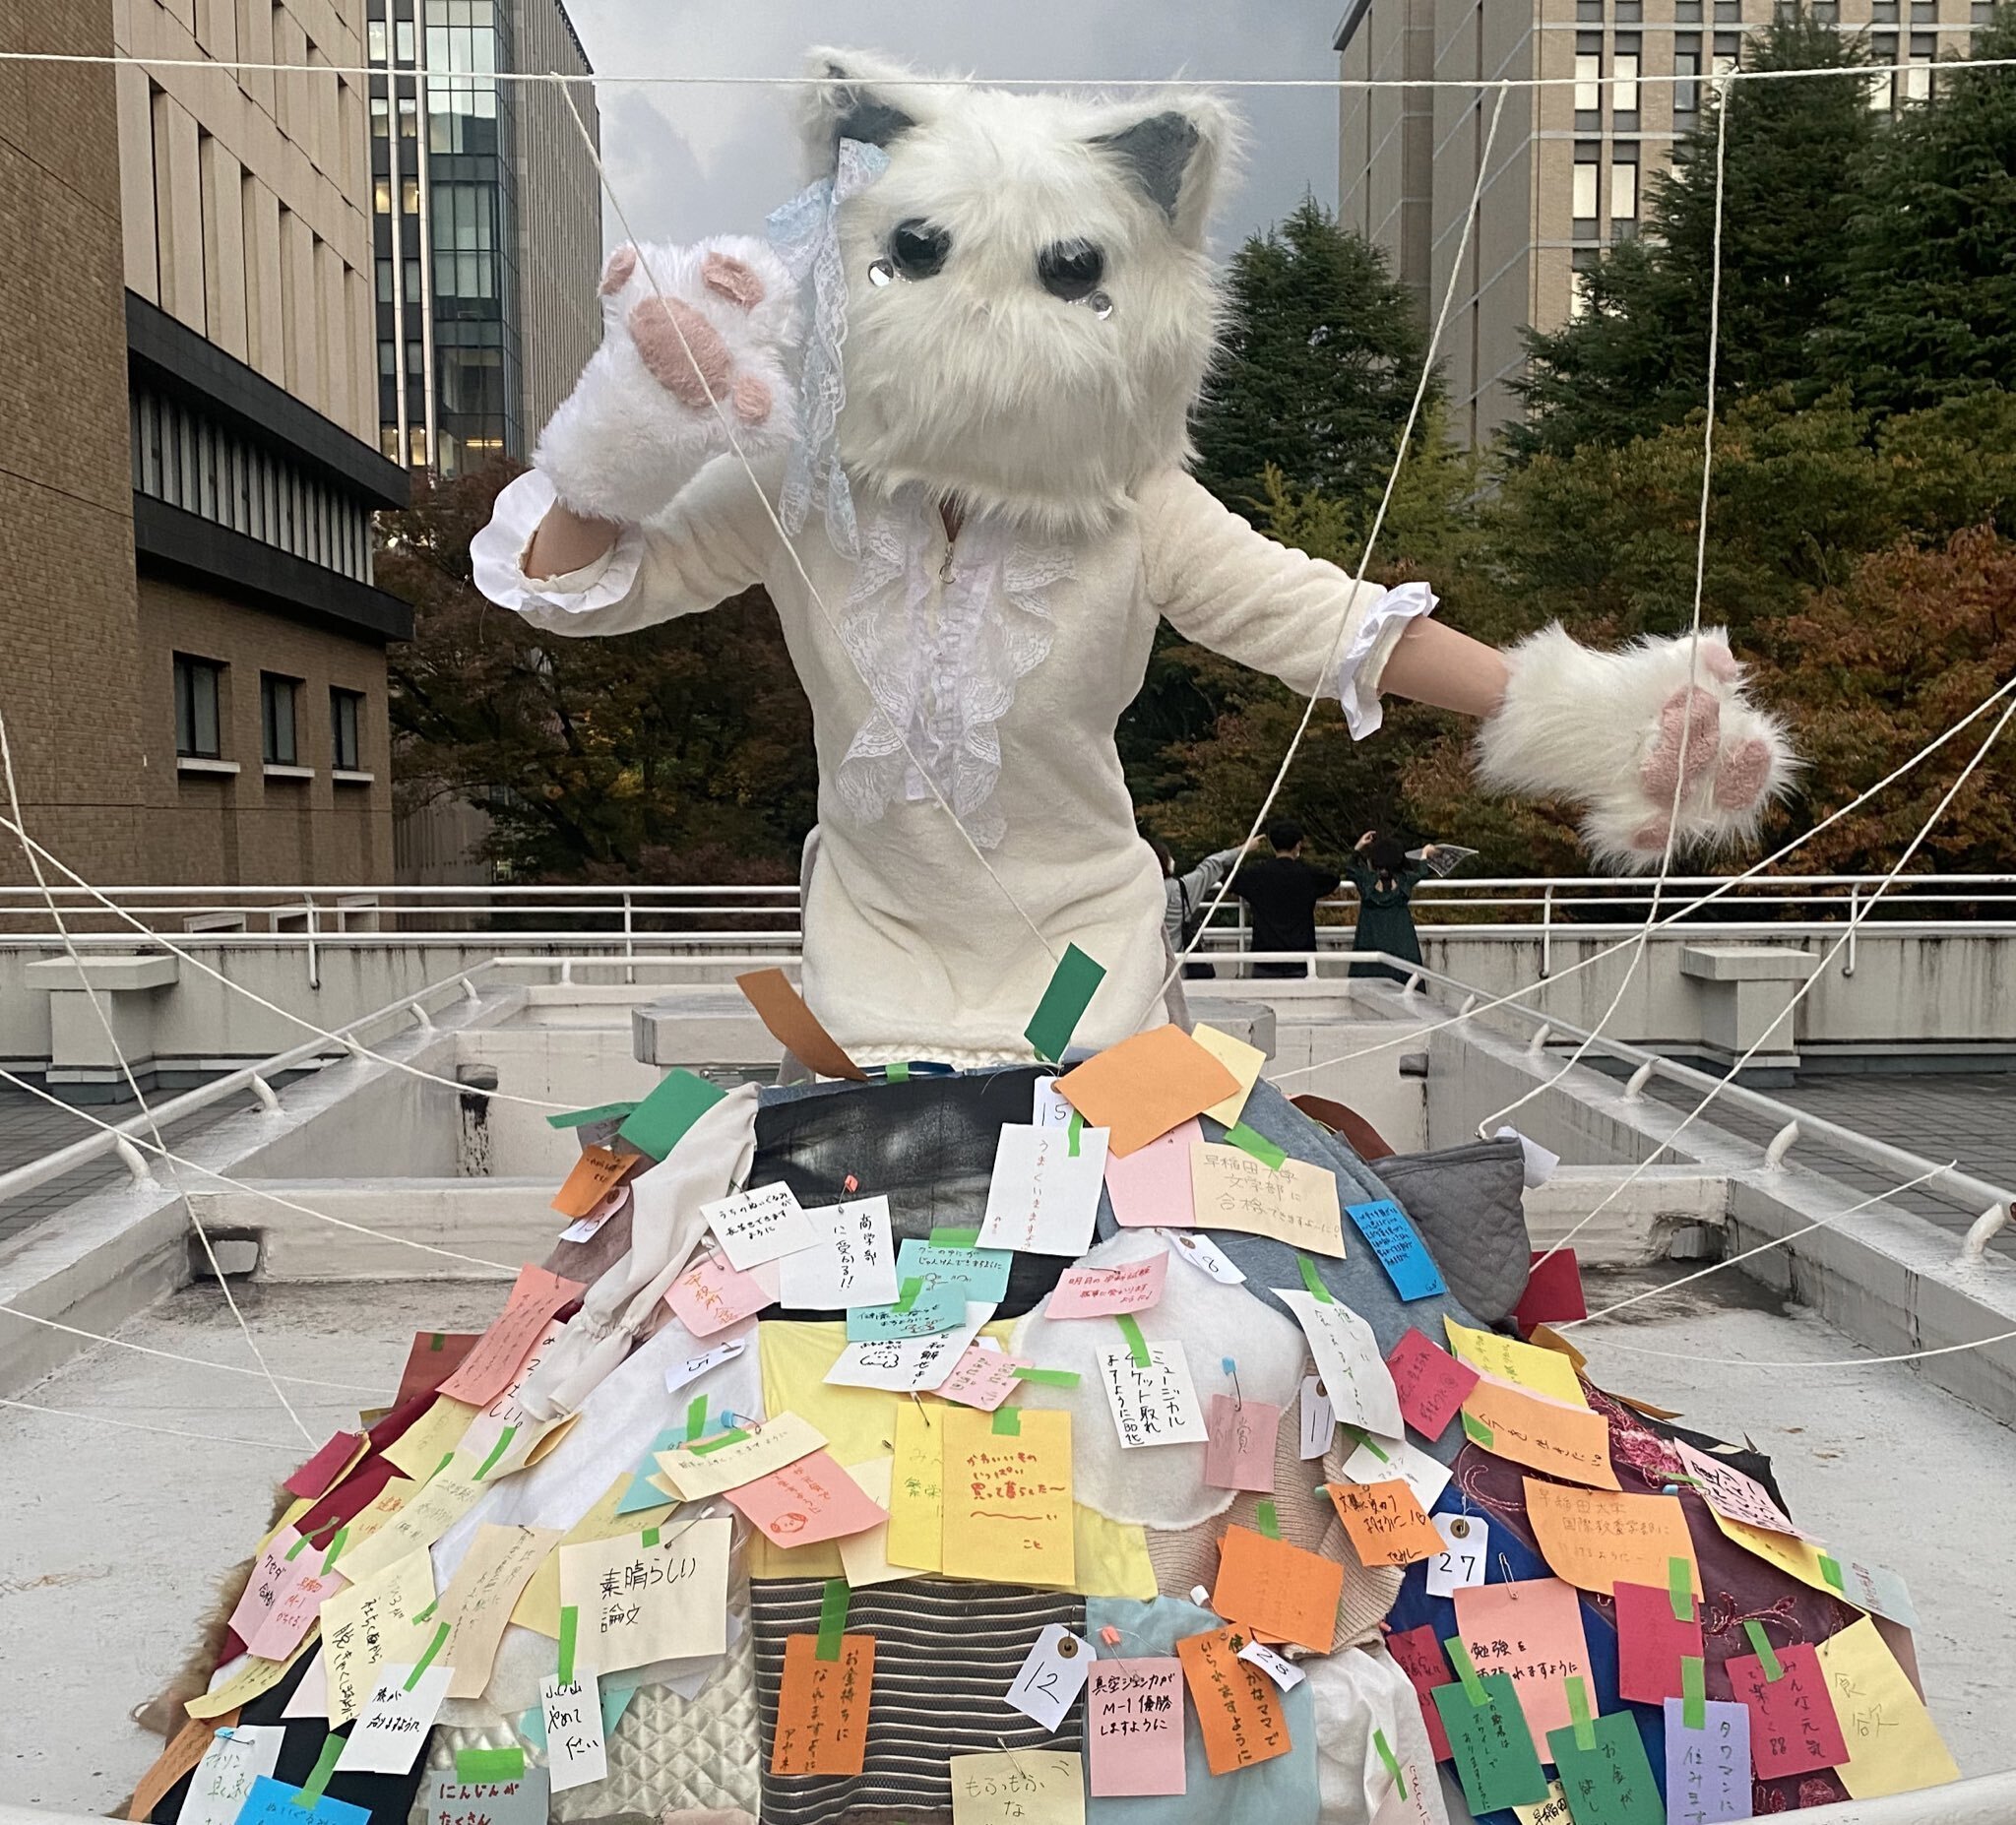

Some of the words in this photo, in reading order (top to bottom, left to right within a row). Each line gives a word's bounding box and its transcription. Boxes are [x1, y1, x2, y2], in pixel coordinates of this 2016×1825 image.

[1041, 1101, 1069, 1126] 15
[1152, 1350, 1186, 1427] ミュージカル
[599, 1557, 696, 1601] 素晴らしい
[1438, 1552, 1477, 1583] 27
[599, 1603, 643, 1634] 論文
[1470, 1639, 1528, 1662] 勉強を
[1023, 1660, 1061, 1705] 12
[1091, 1670, 1175, 1696] 真空ジェシカが
[1102, 1699, 1132, 1717] M-1
[1138, 1696, 1172, 1716] 優勝
[1200, 1641, 1253, 1765] いられますように
[1100, 1719, 1168, 1736] しますように
[439, 1783, 521, 1801] にんじんが
[1003, 1800, 1025, 1818] な
